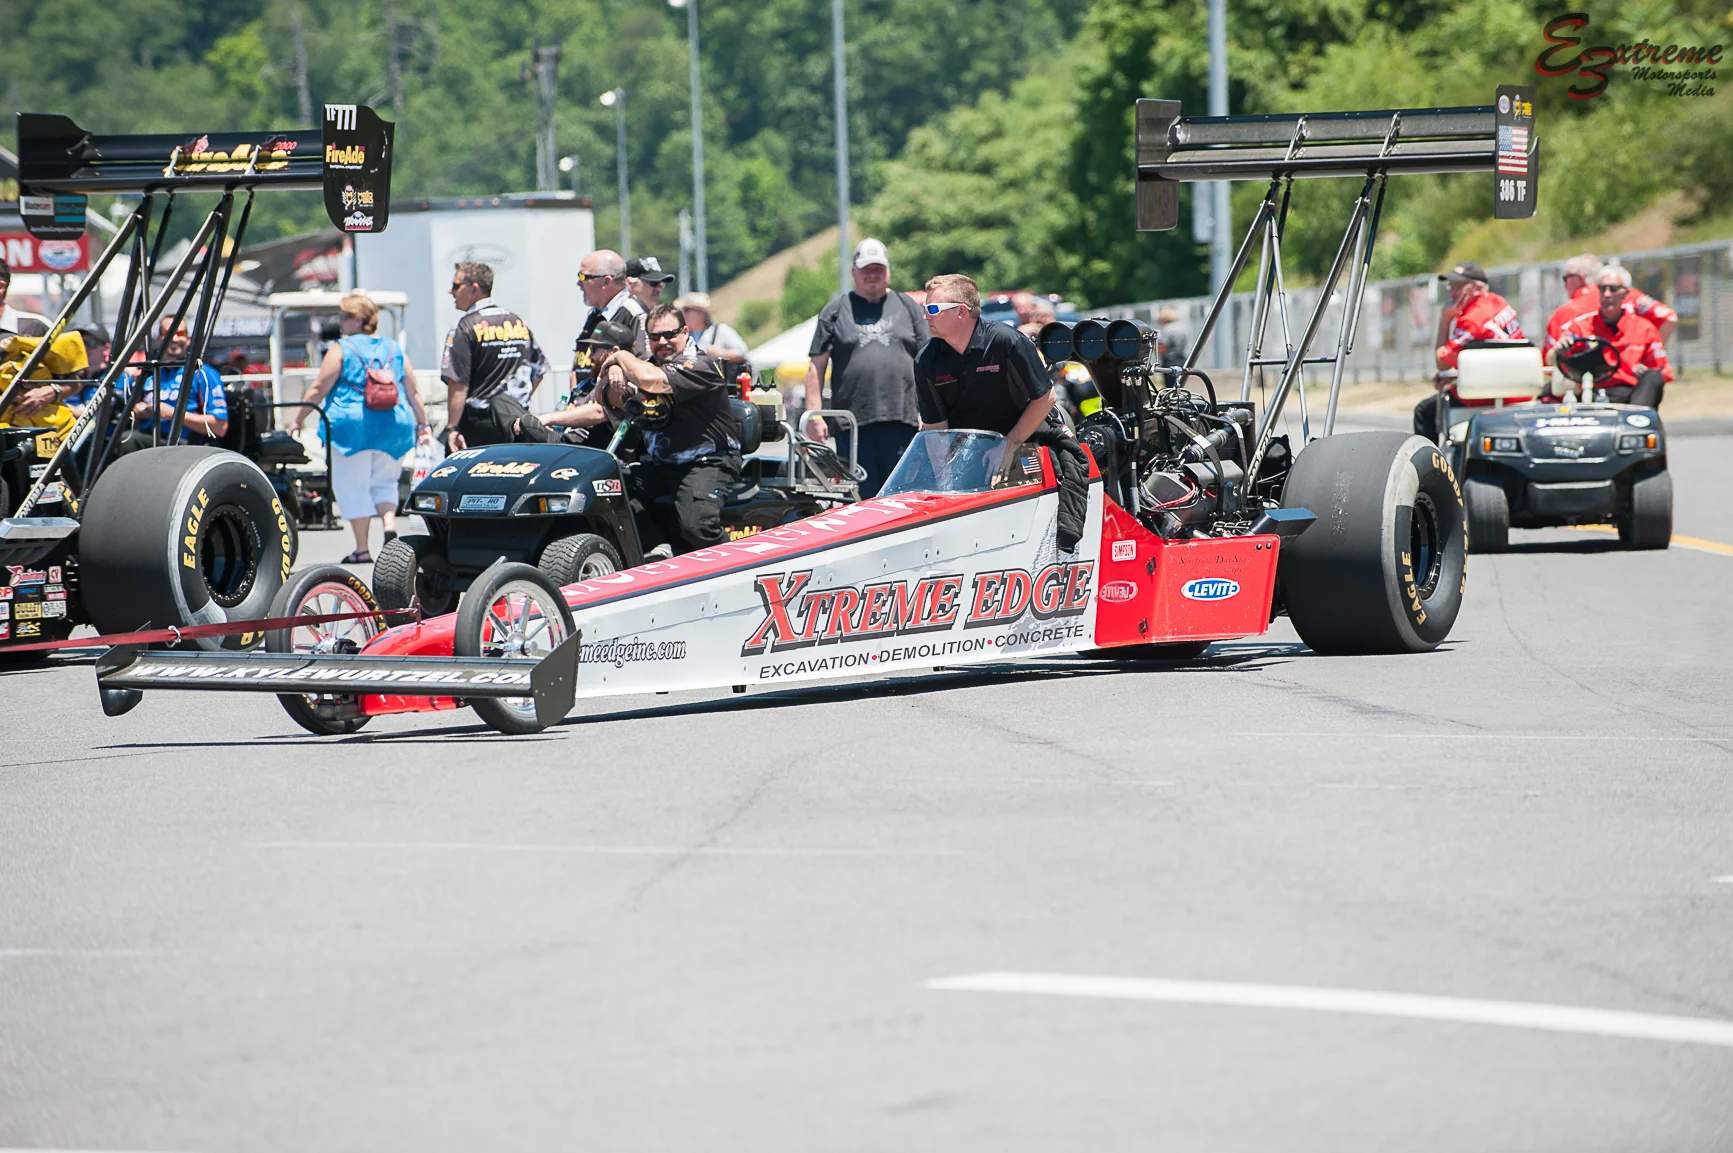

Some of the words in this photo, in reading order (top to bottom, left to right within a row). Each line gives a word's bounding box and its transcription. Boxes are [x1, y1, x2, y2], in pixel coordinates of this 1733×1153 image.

[273, 141, 297, 151] 2000
[325, 143, 365, 165] FireAde
[473, 319, 530, 342] FireAde
[66, 386, 107, 450] GOODYEAR
[467, 461, 535, 475] FireAde
[597, 479, 619, 492] DSR
[183, 487, 210, 570] EAGLE
[1114, 543, 1134, 558] SIMPSON
[1401, 551, 1428, 625] EAGLE
[740, 568, 964, 657] XTREME
[963, 559, 1094, 630] EDGE
[579, 636, 687, 669] meedgeinc.com
[759, 653, 872, 680] EXCAVATION
[878, 638, 986, 664] DEMOLITION
[994, 625, 1084, 648] CONCRETE
